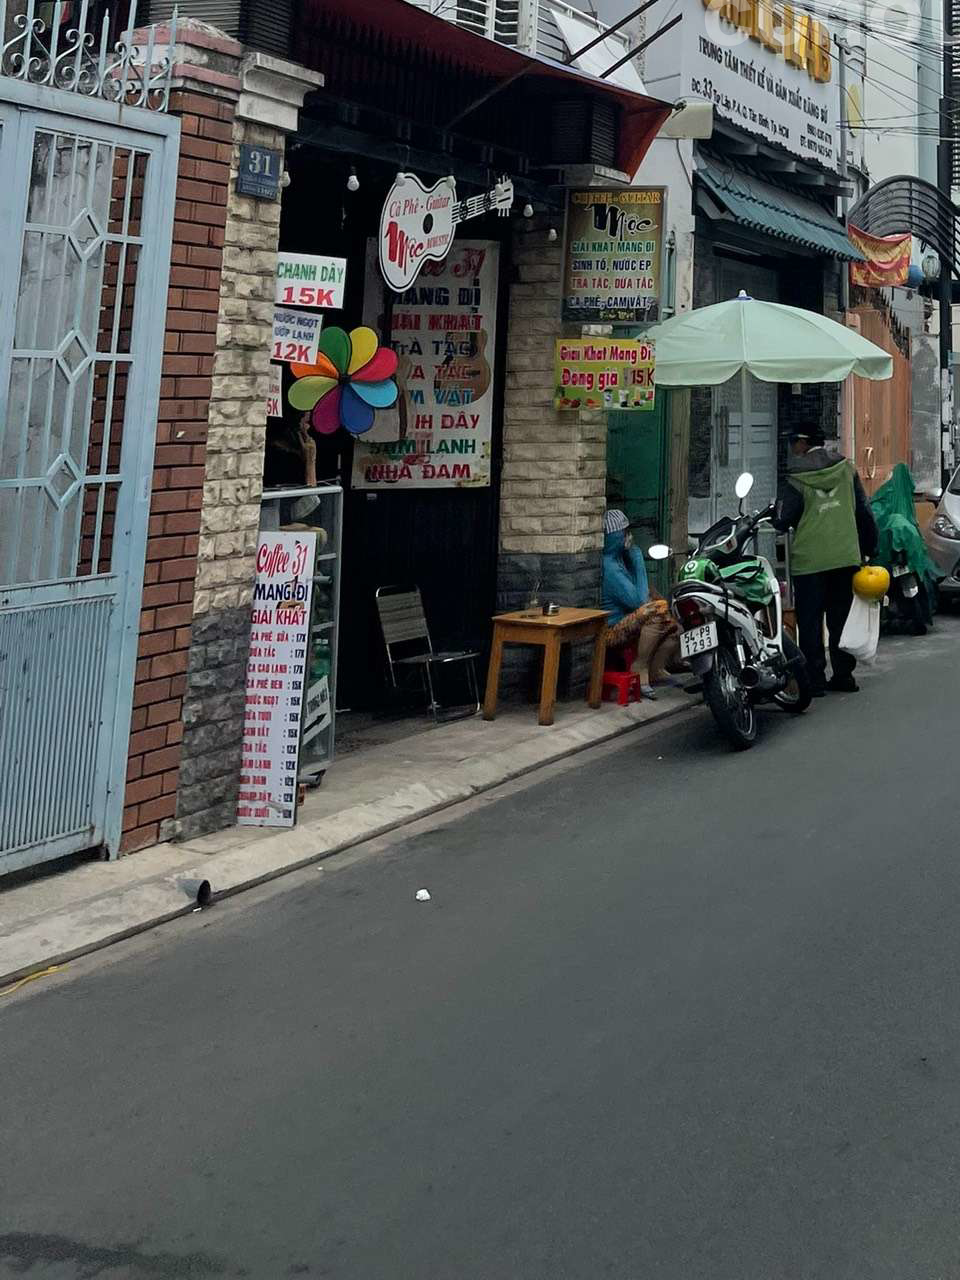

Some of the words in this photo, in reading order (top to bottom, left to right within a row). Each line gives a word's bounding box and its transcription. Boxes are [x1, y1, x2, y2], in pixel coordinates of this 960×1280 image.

[699, 35, 722, 64] TRUNG
[724, 49, 738, 74] TÂM
[740, 58, 756, 84] THIẾT
[703, 77, 712, 99] 33
[249, 151, 272, 177] 31
[389, 201, 402, 218] Cà
[402, 198, 419, 216] Phê
[426, 195, 450, 211] Guitar
[618, 241, 643, 253] MANG
[276, 262, 316, 281] CHANH
[320, 262, 344, 284] DÂY
[572, 260, 592, 271] SINH
[282, 287, 335, 306] 15K
[607, 296, 626, 308] CAM
[273, 342, 312, 363] 12K
[610, 346, 637, 364] Mang
[266, 398, 279, 415] 5K
[441, 411, 480, 429] DÂY
[421, 464, 471, 479] ĐAM
[256, 543, 290, 577] Coffee
[292, 543, 308, 575] 31
[254, 583, 291, 601] MANG
[297, 584, 309, 601] ĐI
[685, 636, 712, 656] 1293
